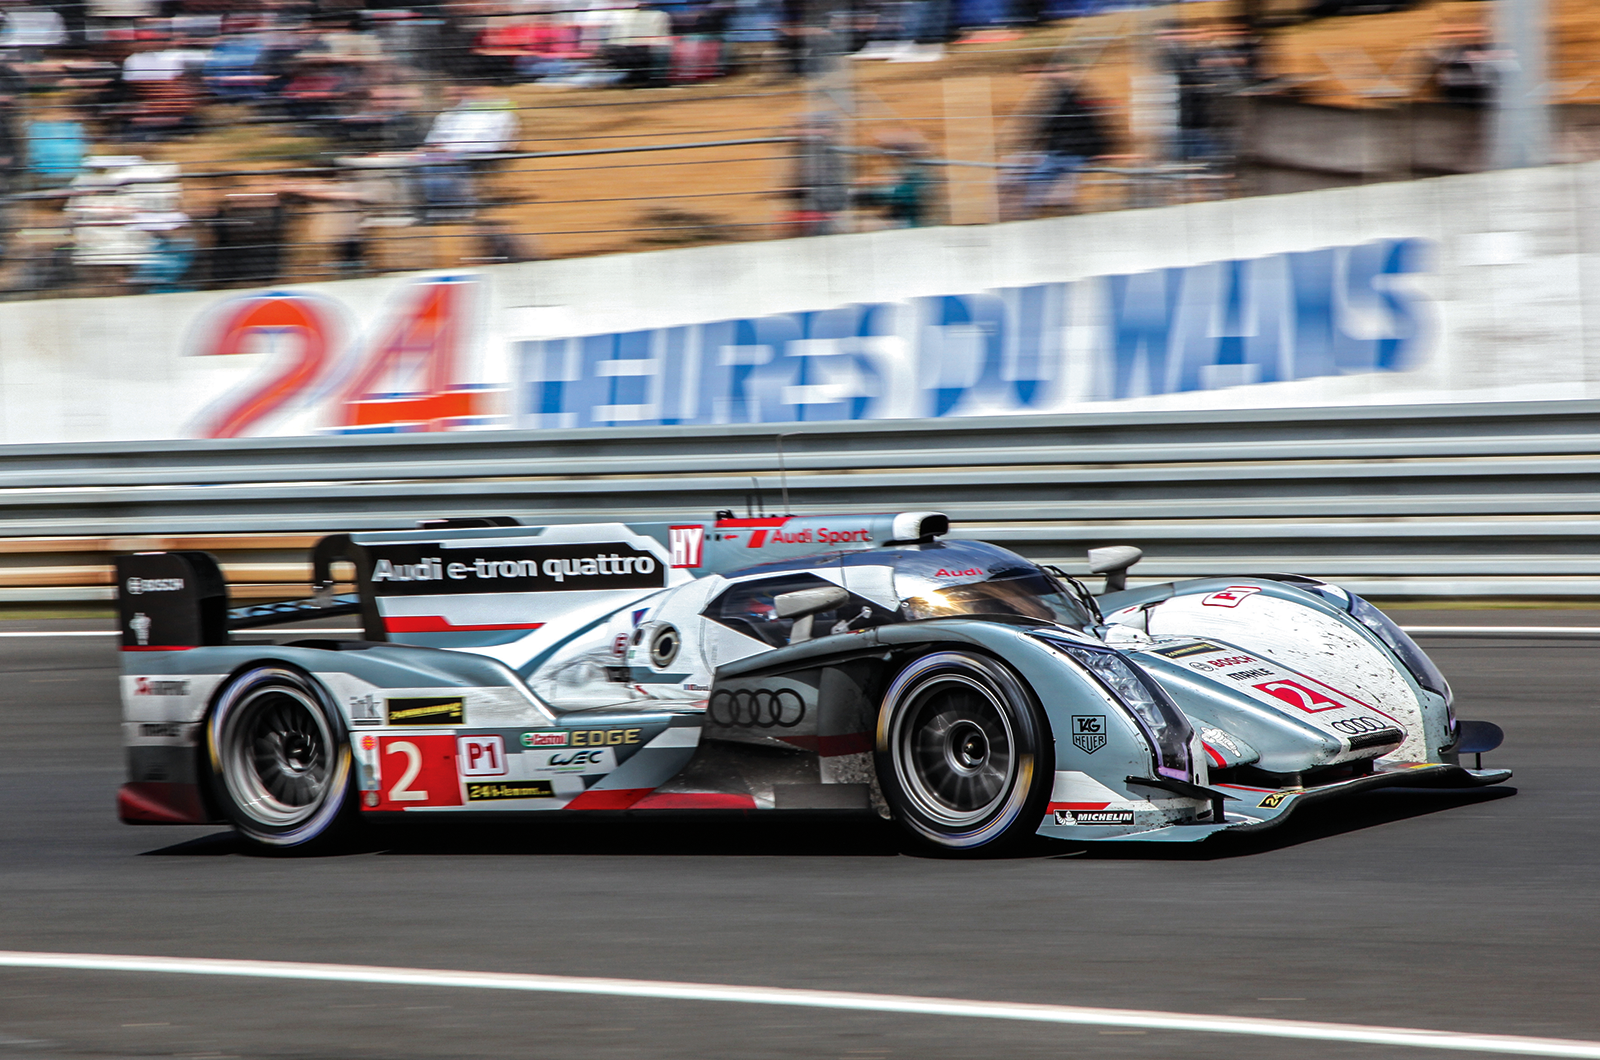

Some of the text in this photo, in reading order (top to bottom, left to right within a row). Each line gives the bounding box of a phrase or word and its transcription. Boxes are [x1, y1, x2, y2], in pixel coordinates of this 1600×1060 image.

[192, 272, 498, 438] 24
[769, 527, 869, 546] Audi Sport
[669, 527, 703, 565] HY
[371, 553, 655, 582] Audi e-tron quattro
[935, 567, 984, 578] Audi
[1207, 655, 1258, 668] BOSCH
[1264, 683, 1336, 711] 2
[1077, 718, 1100, 732] TAG
[570, 728, 641, 746] EDGE
[1075, 735, 1104, 751] HEUER
[467, 743, 499, 770] P1
[547, 750, 603, 766] WEC
[385, 741, 429, 801] 2
[1077, 813, 1133, 821] MICHELIN
